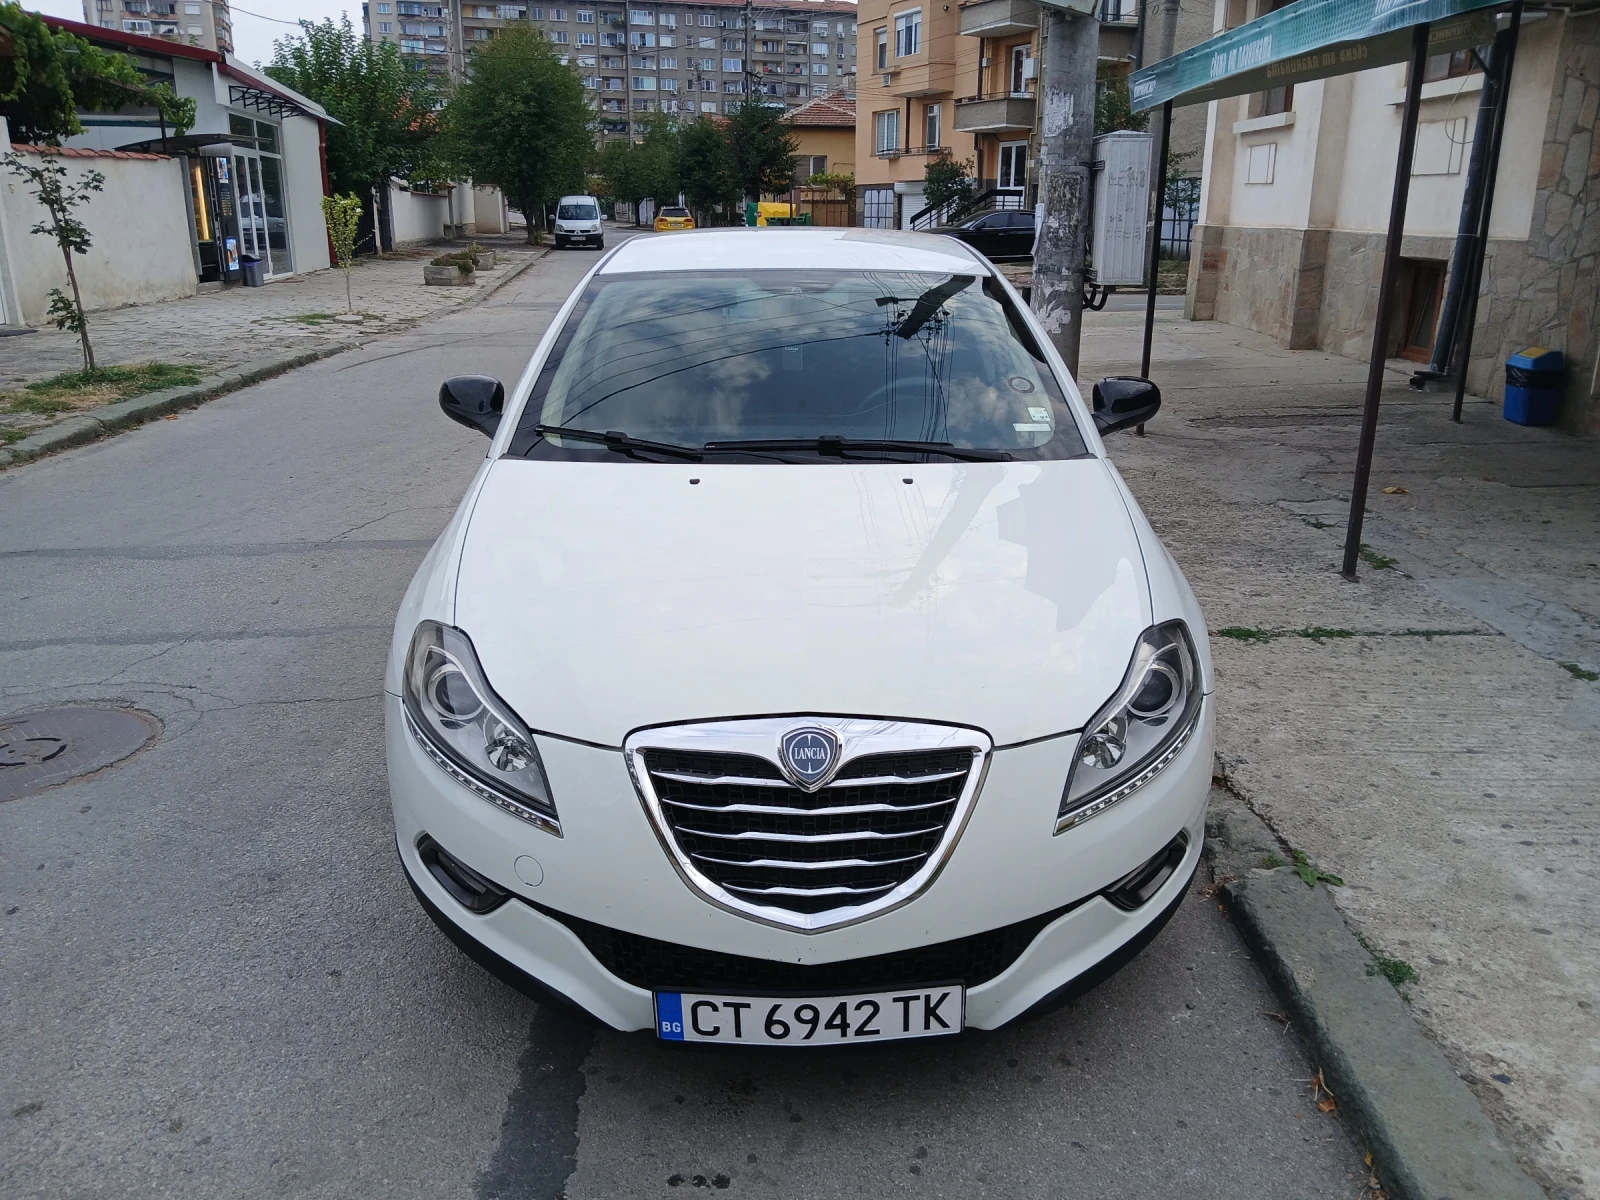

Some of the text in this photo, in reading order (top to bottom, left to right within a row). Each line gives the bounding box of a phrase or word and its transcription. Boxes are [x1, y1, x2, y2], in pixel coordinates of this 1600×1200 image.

[794, 747, 826, 760] LANCIA
[662, 992, 951, 1040] BG CT 6942 TK
